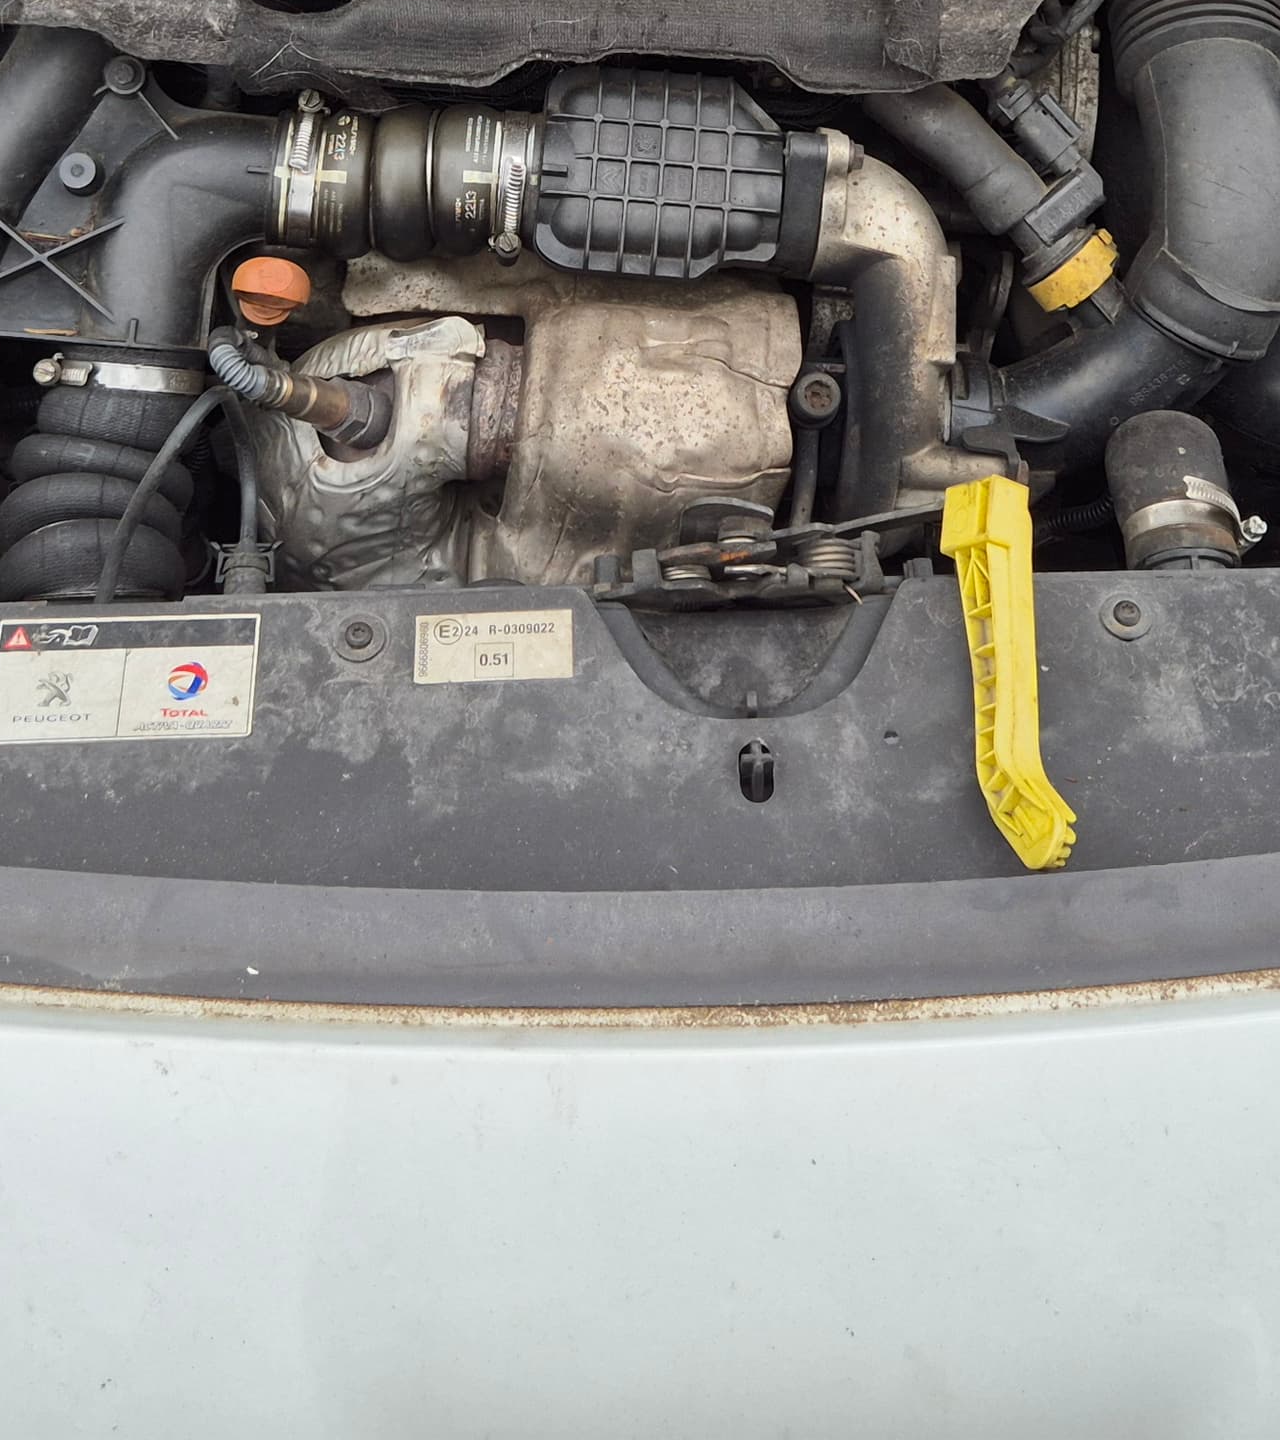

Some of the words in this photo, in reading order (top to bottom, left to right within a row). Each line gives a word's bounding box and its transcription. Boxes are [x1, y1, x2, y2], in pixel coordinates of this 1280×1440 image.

[465, 626, 478, 635] 24
[489, 623, 555, 635] R-0309022
[480, 654, 508, 666] 0.51
[13, 713, 91, 723] PEUGEOT
[160, 708, 208, 717] TOTAL
